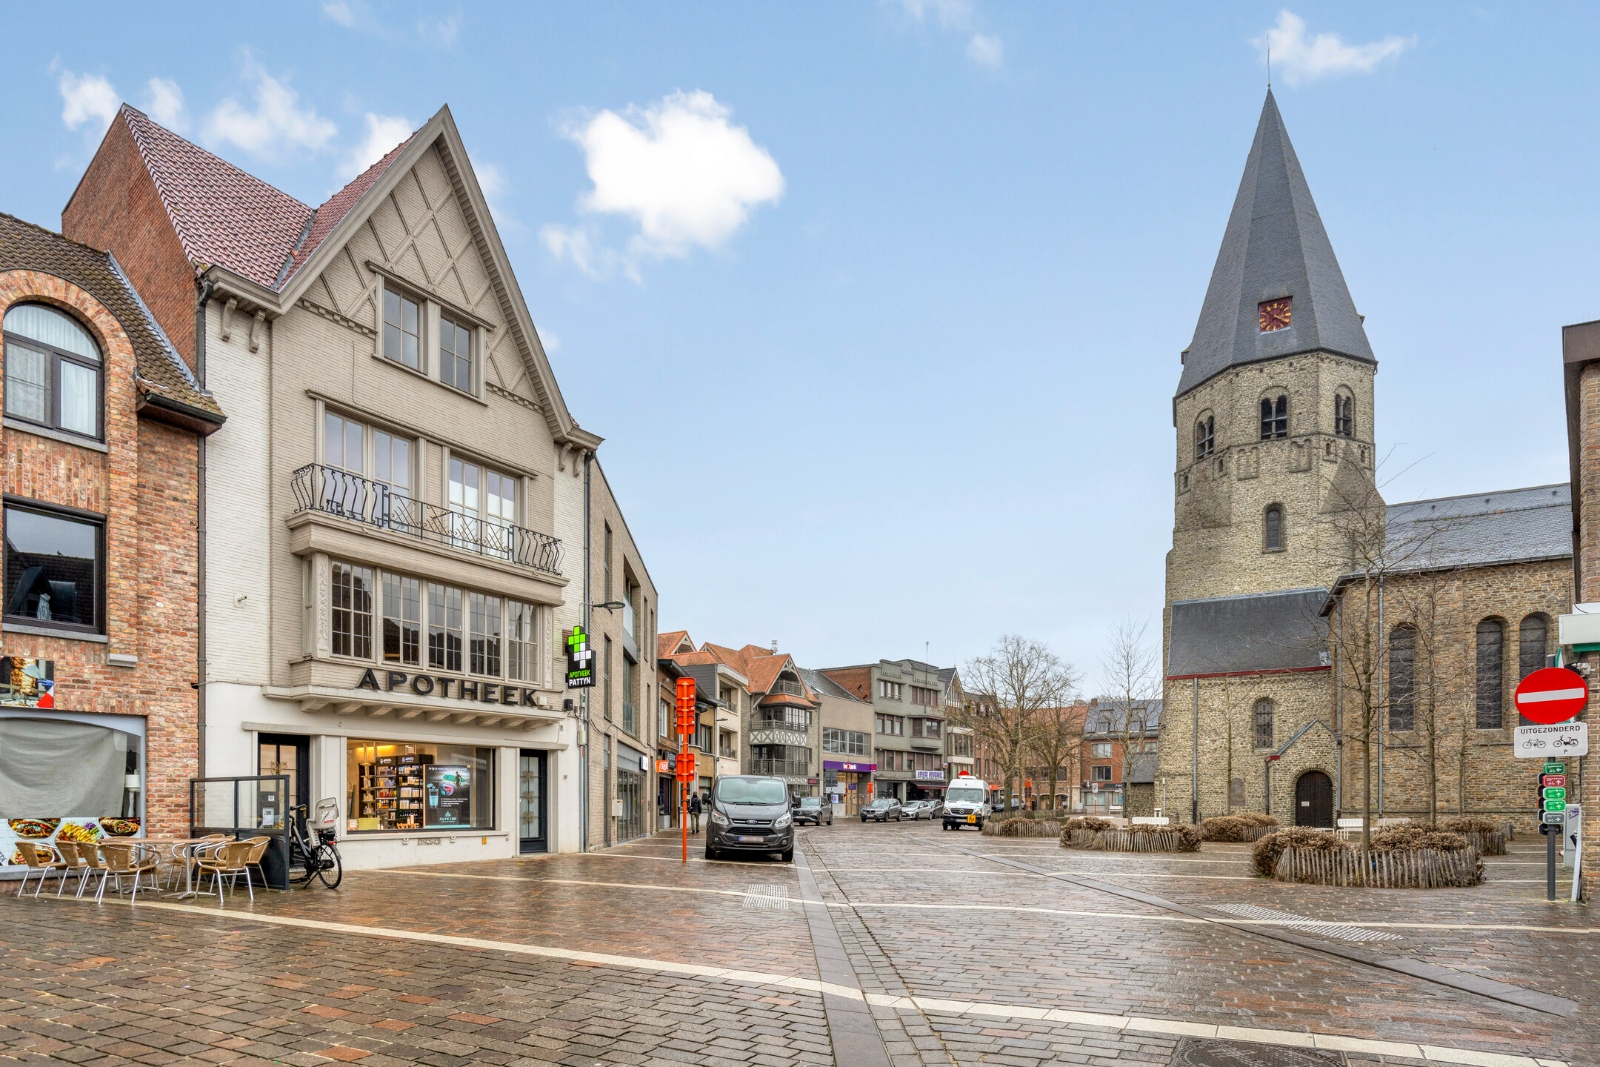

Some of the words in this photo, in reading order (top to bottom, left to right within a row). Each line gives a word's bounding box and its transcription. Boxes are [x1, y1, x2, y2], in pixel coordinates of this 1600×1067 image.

[569, 669, 591, 678] APOTHEEK
[356, 668, 538, 706] APOTHEEK
[568, 677, 591, 687] PATTYN
[1520, 725, 1581, 735] UITGEZONDERD
